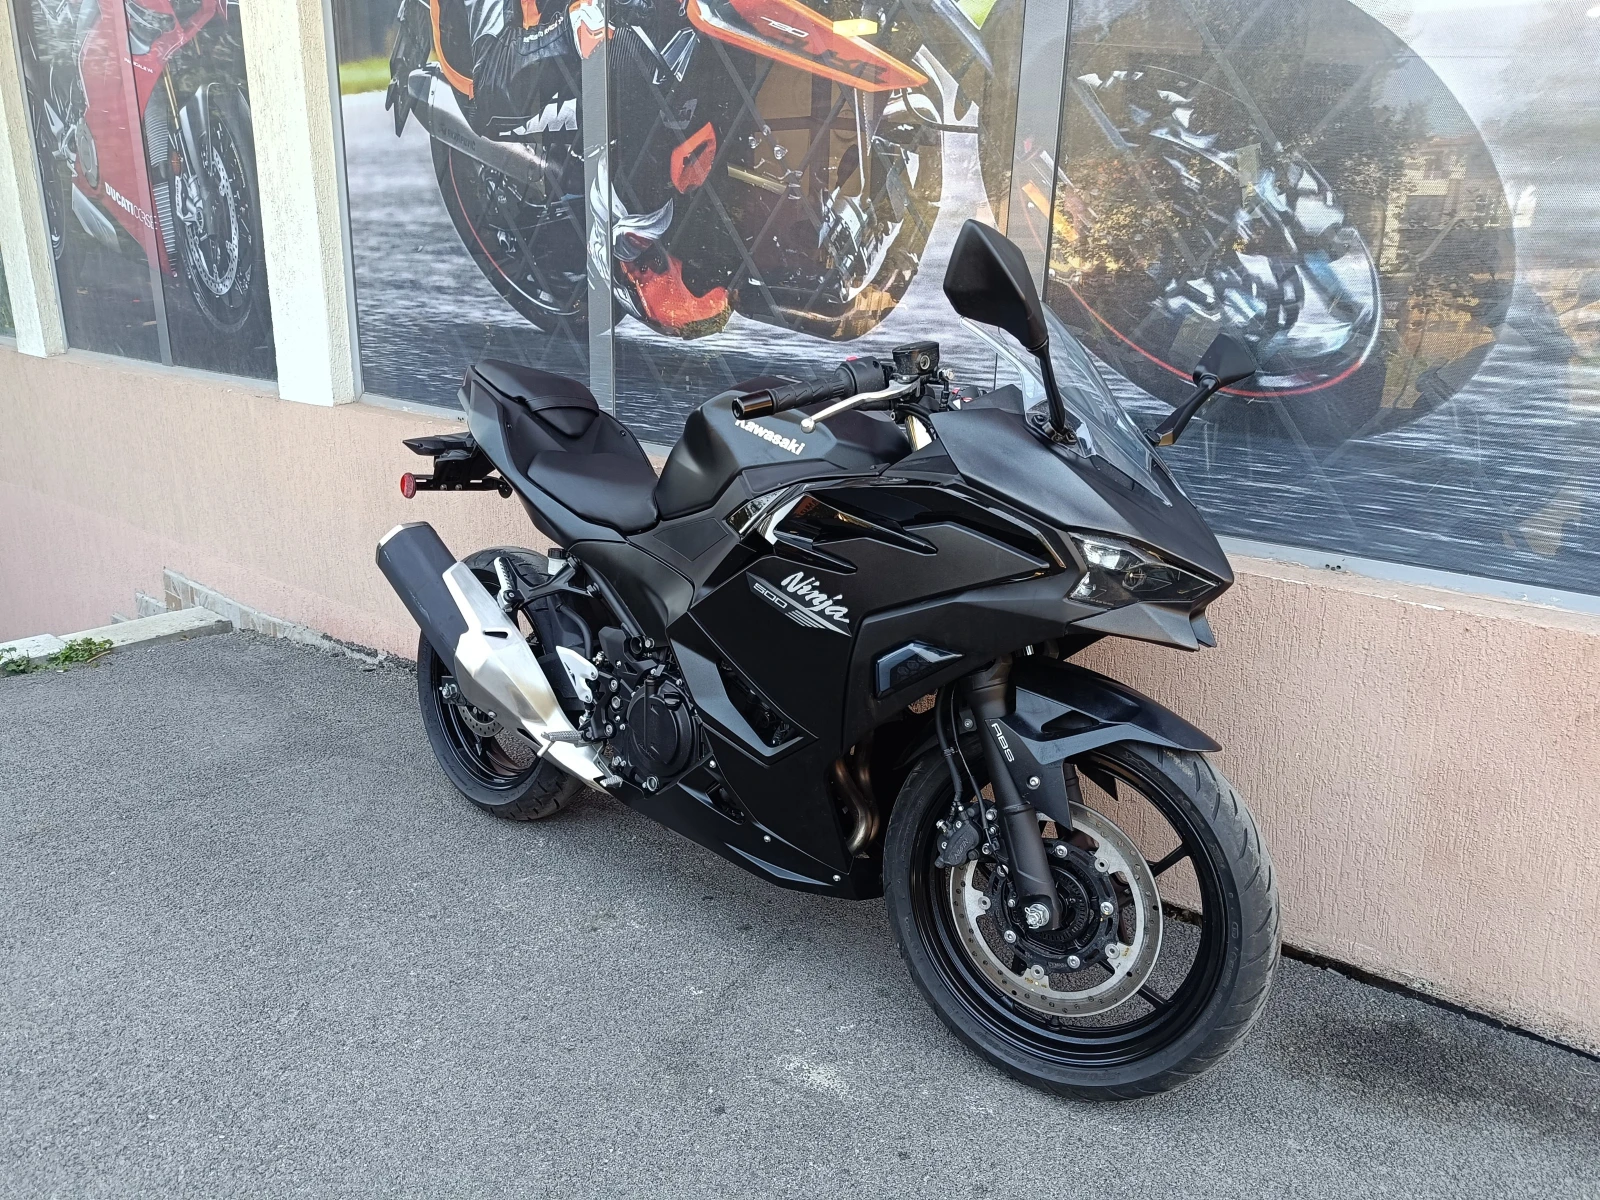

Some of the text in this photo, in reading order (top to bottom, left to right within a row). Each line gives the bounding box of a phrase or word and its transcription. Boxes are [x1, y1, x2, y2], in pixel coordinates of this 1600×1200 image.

[104, 181, 134, 216] DUCATI
[735, 419, 806, 456] Kawasaki
[753, 582, 788, 609] 500
[780, 571, 850, 624] Ninja
[991, 722, 1015, 763] ABS
